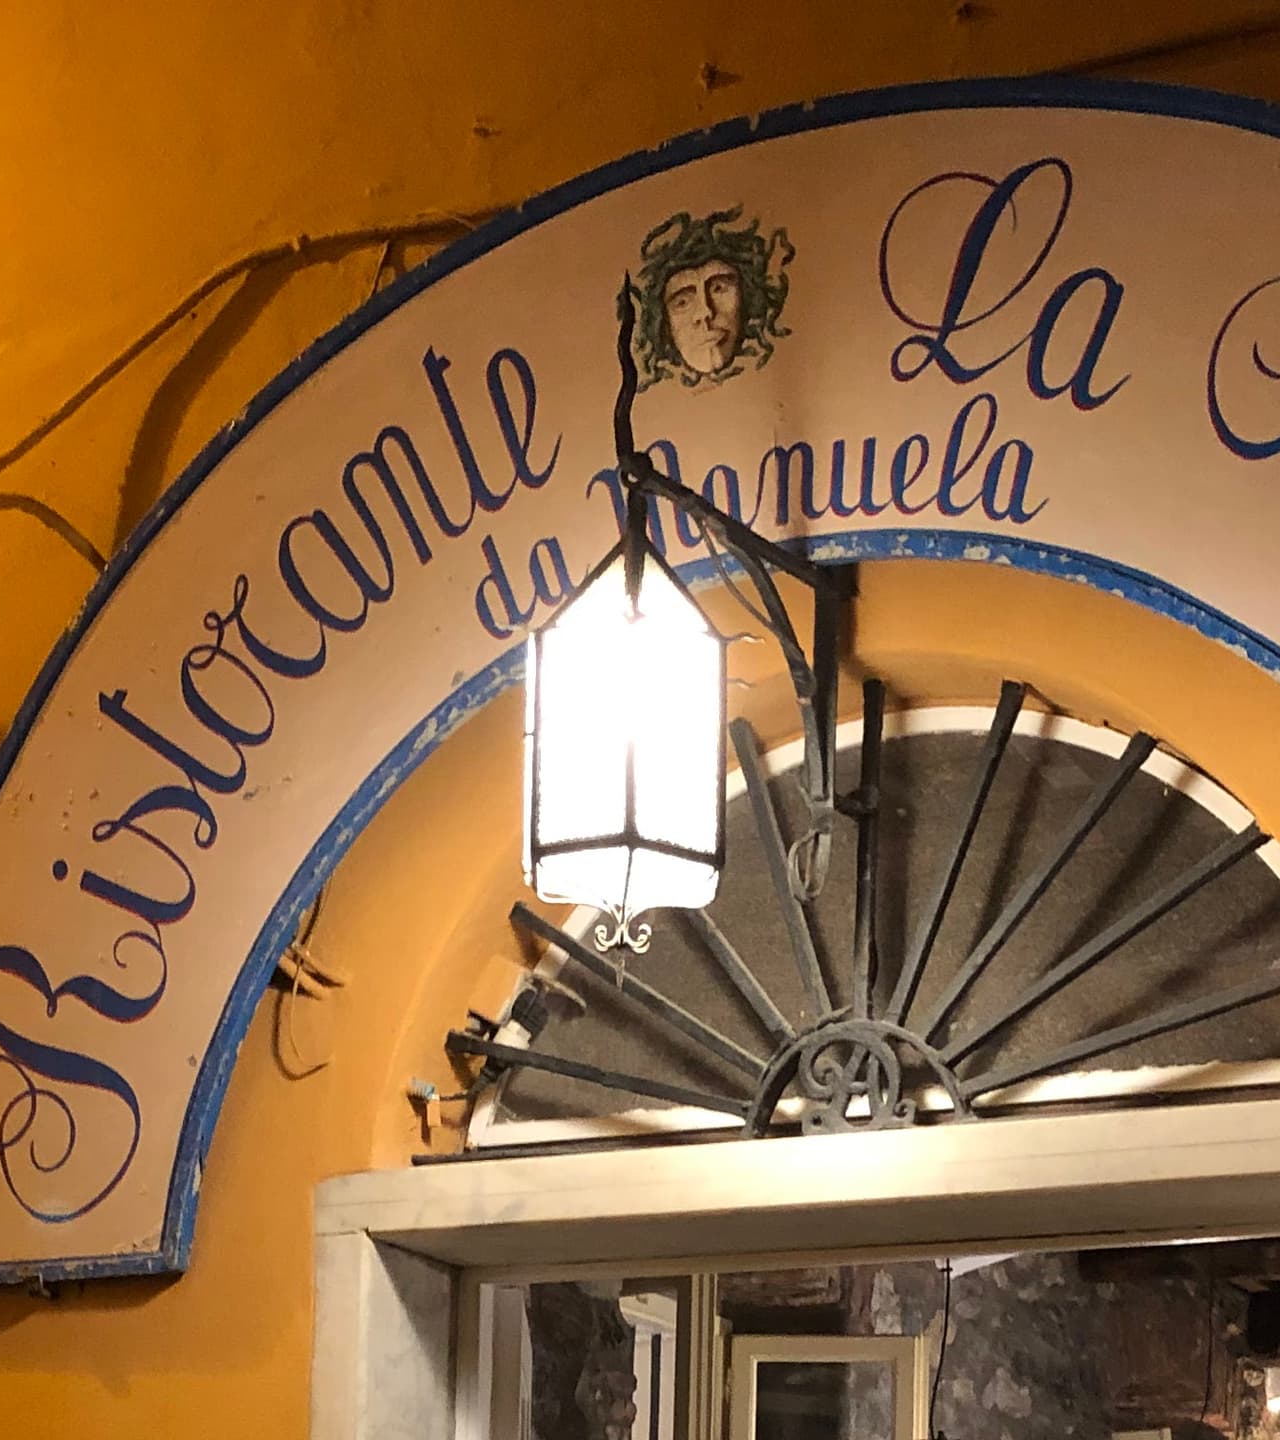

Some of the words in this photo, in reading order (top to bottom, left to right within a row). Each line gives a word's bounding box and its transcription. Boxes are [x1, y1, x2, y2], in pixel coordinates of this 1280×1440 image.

[879, 157, 1132, 411] La
[475, 533, 590, 640] da
[586, 392, 1049, 556] Manuela
